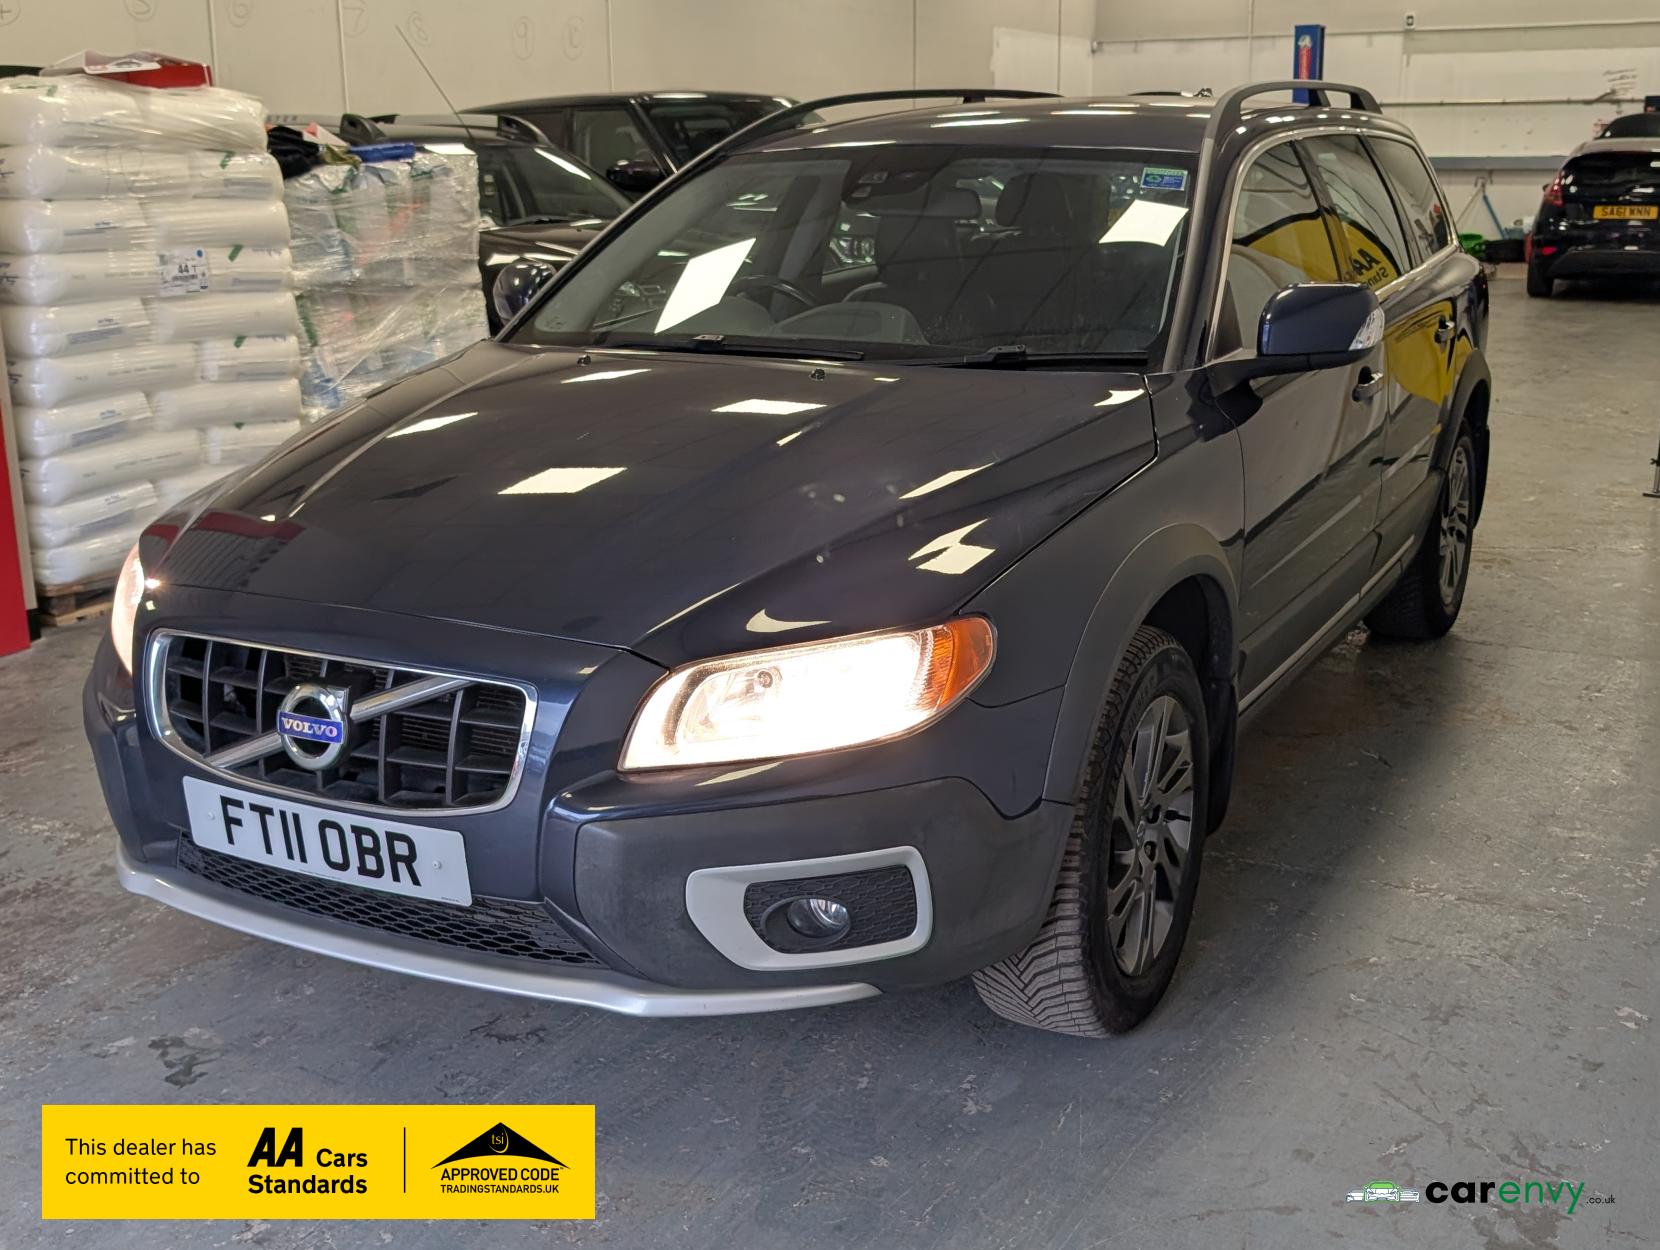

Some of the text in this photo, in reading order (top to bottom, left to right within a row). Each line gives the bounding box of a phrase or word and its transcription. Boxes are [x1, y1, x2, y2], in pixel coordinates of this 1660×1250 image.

[281, 717, 338, 738] VOLVO
[219, 795, 422, 888] FT11 OBR
